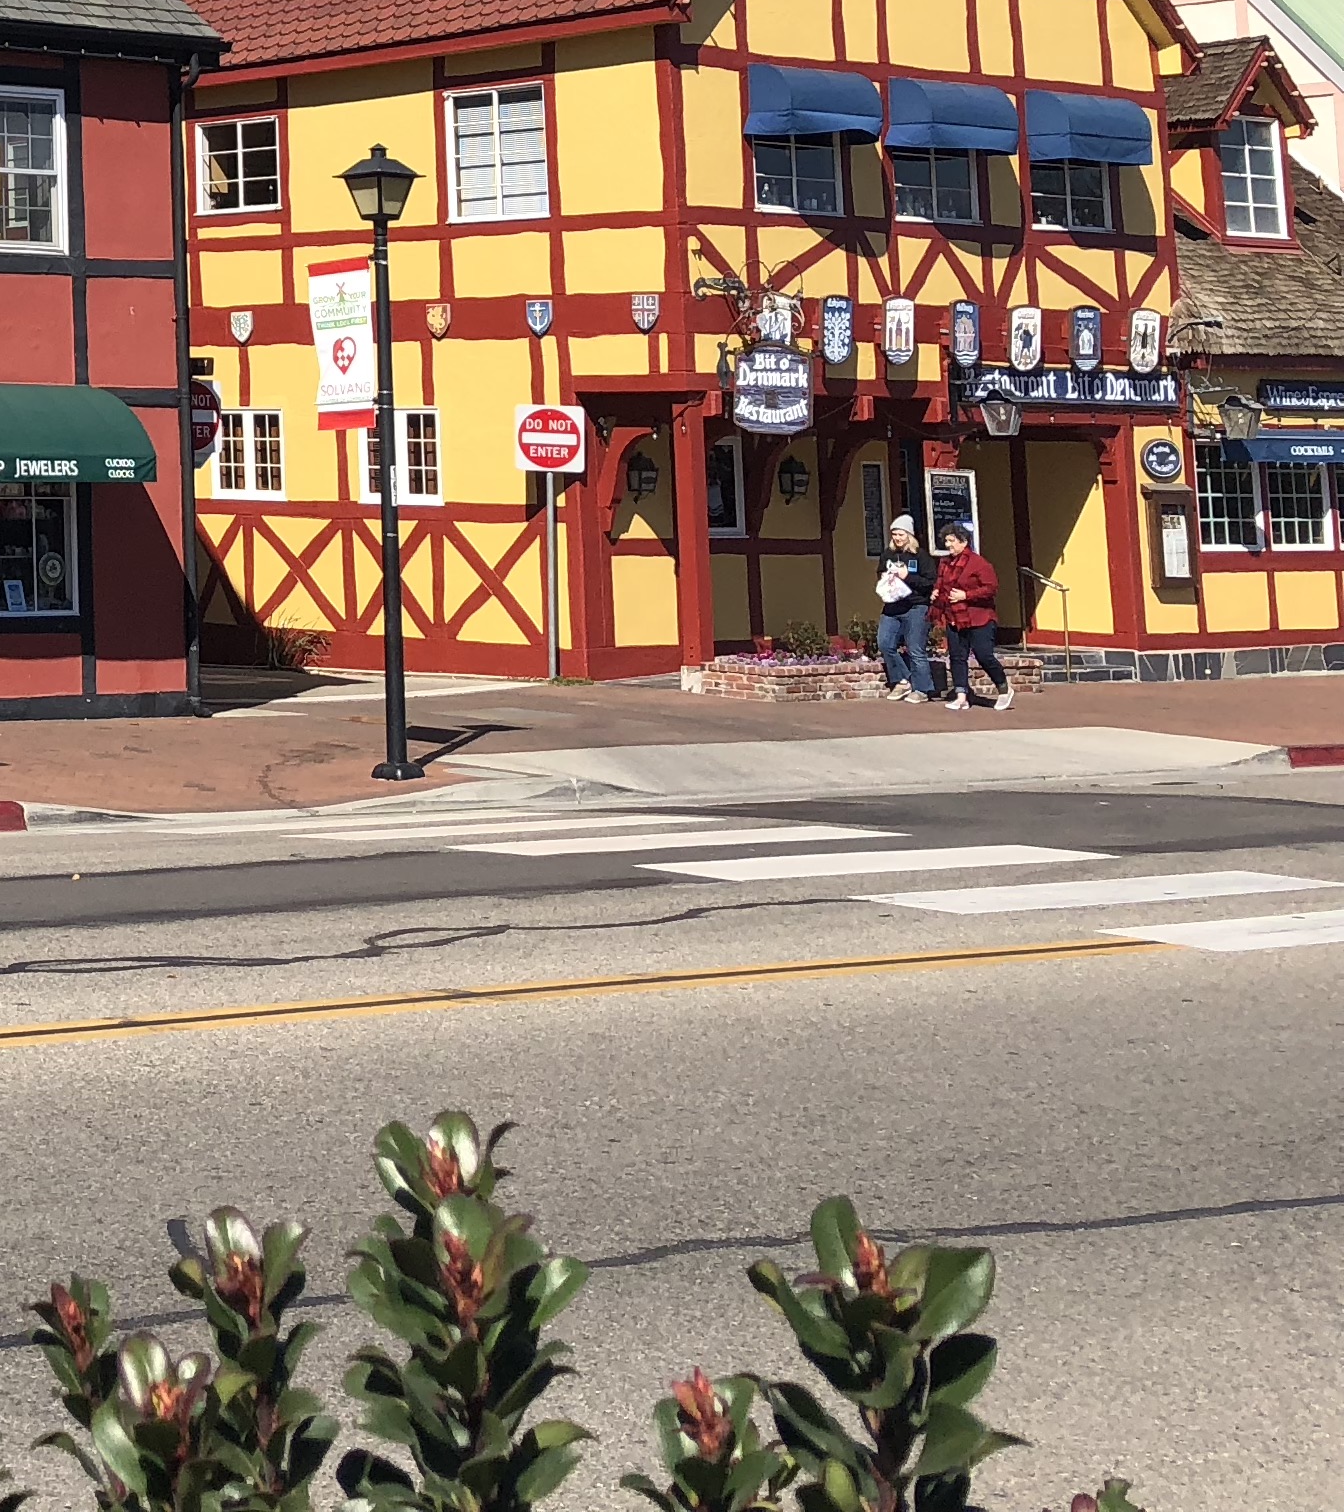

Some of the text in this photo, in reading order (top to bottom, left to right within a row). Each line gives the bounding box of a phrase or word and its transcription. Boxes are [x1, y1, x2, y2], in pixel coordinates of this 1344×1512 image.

[313, 295, 335, 304] GROW
[753, 353, 776, 369] Bit
[736, 361, 808, 388] Denmark
[320, 382, 371, 396] SOLVANG
[1065, 371, 1092, 399] Bit
[1105, 373, 1176, 401] Denmark
[191, 394, 211, 406] NOT
[735, 395, 808, 424] Restaurant
[526, 419, 572, 431] DO NOT
[529, 446, 569, 458] ENTER
[1291, 446, 1334, 456] COCKTAILS
[14, 458, 79, 478] JEWELERS
[105, 458, 135, 468] CUCKOO
[108, 469, 135, 478] CLOCKS
